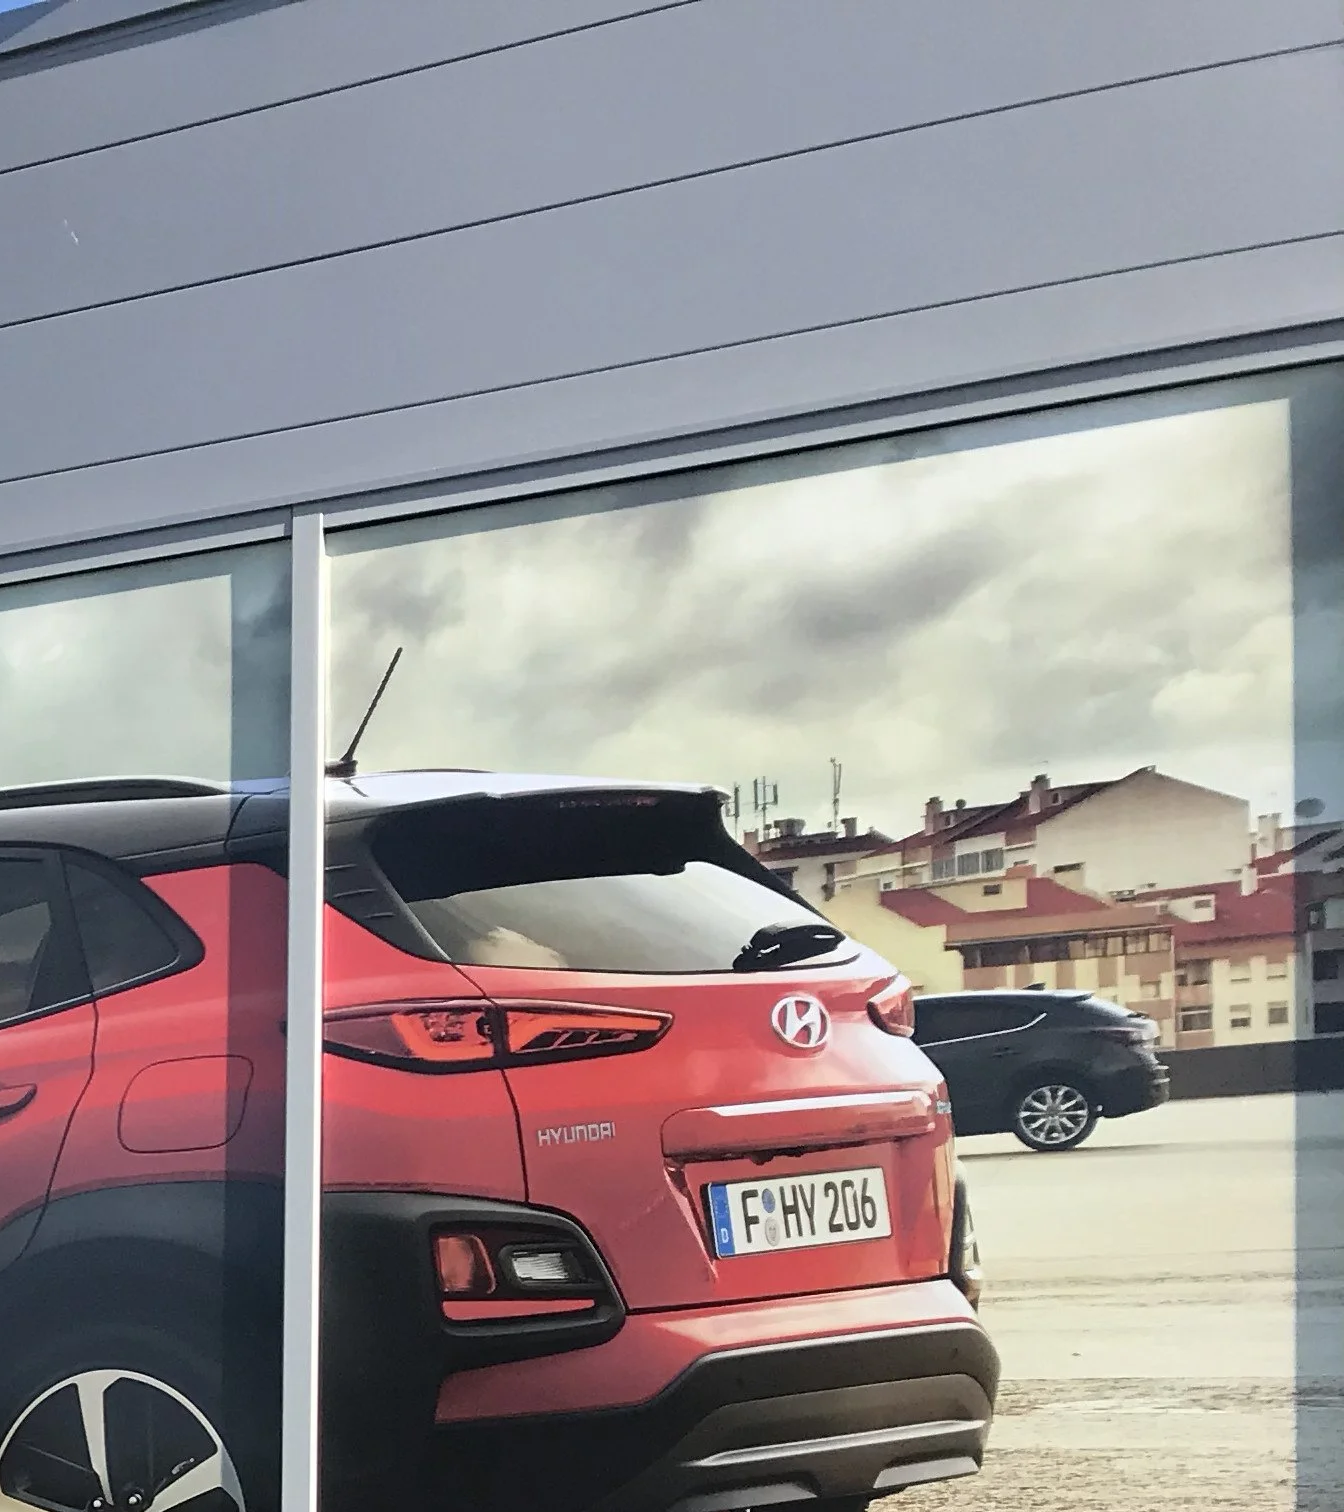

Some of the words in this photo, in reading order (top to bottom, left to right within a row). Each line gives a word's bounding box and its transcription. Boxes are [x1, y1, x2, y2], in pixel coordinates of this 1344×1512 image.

[536, 1120, 616, 1148] HYUNDAI
[740, 1188, 761, 1244] F
[778, 1182, 817, 1239] HY
[823, 1176, 878, 1234] 206
